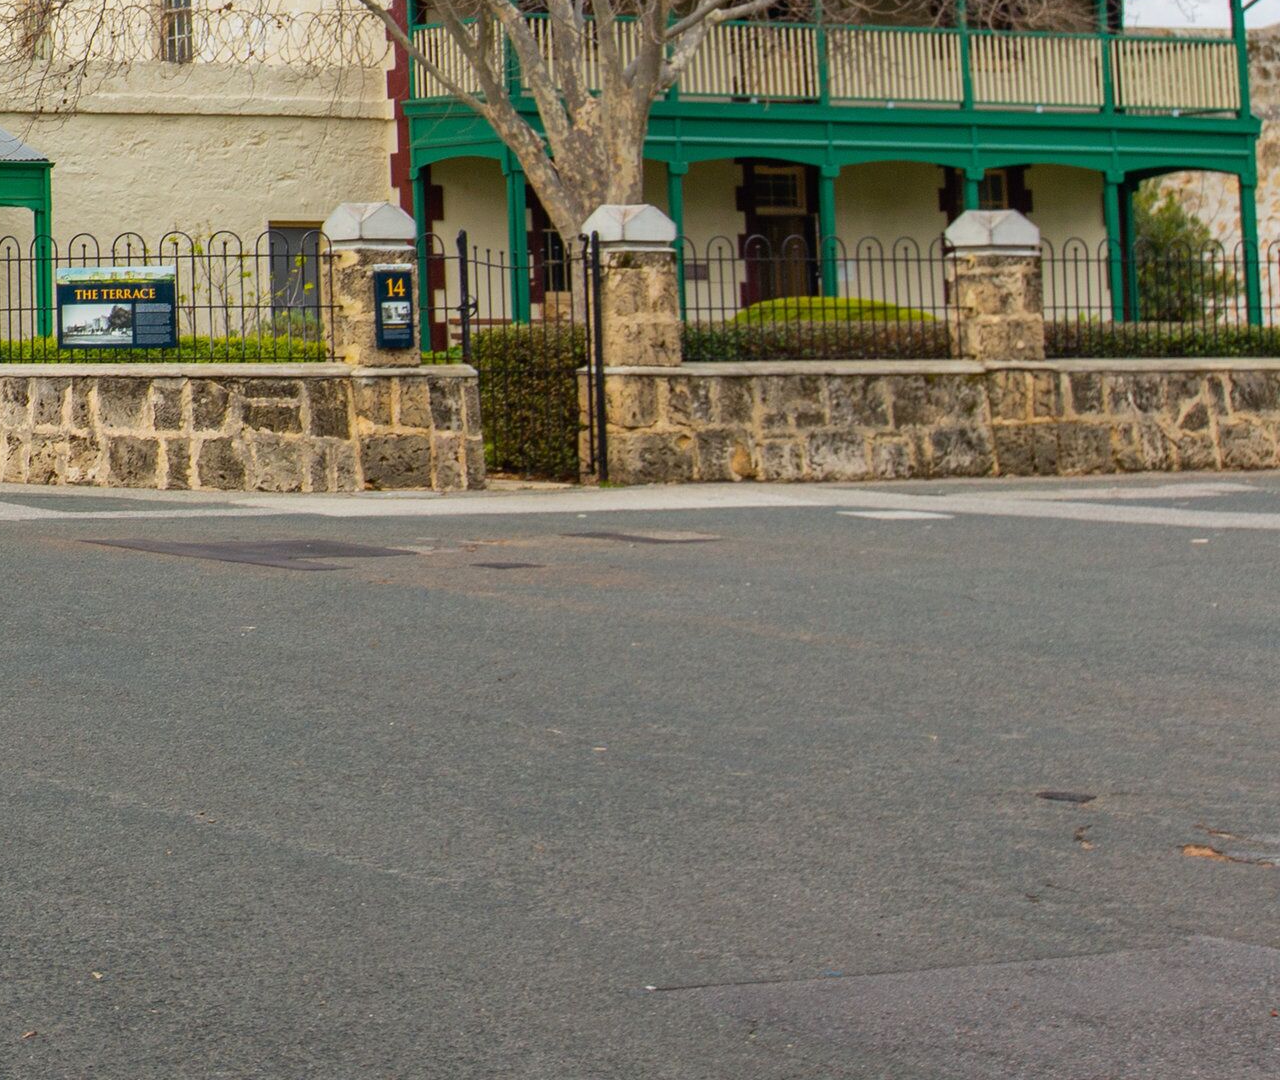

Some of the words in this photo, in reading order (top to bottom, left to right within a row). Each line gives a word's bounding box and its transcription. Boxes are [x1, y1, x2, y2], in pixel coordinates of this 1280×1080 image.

[74, 289, 98, 300] THE
[101, 288, 156, 300] TERRACE
[386, 278, 406, 297] 14
